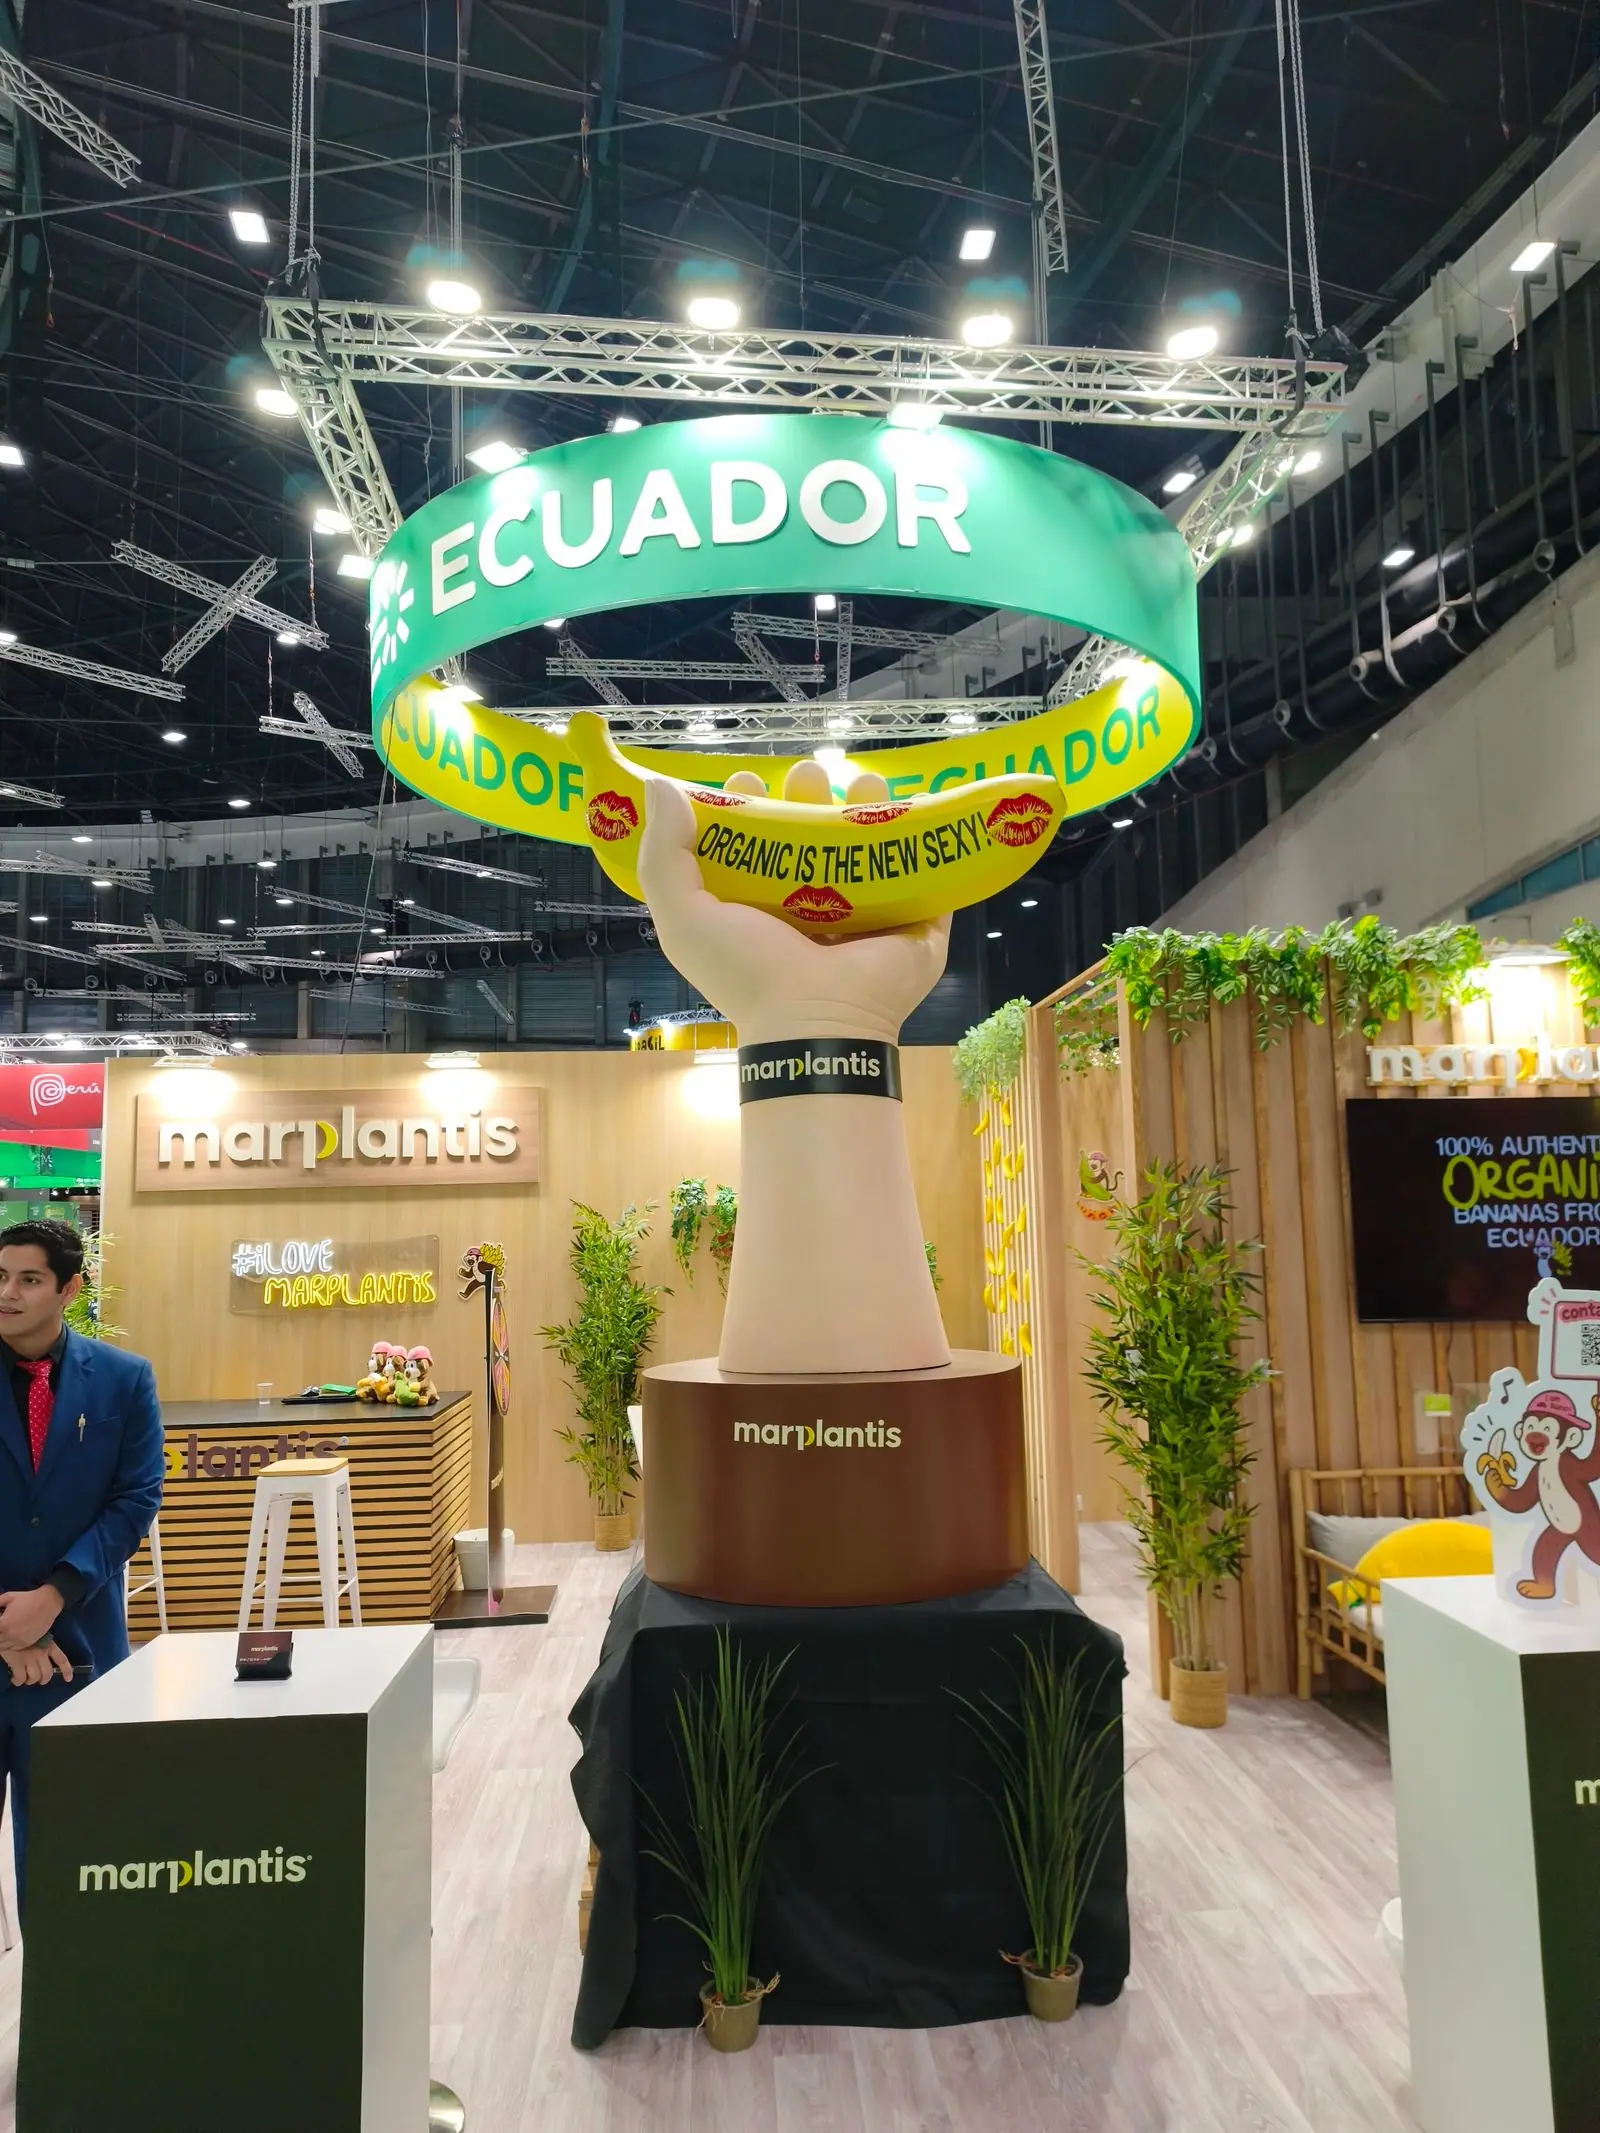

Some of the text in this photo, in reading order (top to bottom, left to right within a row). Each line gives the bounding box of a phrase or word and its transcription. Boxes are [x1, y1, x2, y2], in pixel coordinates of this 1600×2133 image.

[432, 459, 972, 616] ECUADOR
[388, 690, 583, 811] CUADOR
[698, 811, 992, 883] ORGANIC IS THE NEW SEXY!
[740, 1050, 881, 1083] marplantis
[1370, 1036, 1600, 1089] marpla
[158, 1105, 519, 1169] marplantis
[1435, 1136, 1494, 1156] 100%
[1454, 1203, 1559, 1225] BANANAS
[1487, 1226, 1600, 1248] ECUADOR
[733, 1419, 902, 1451] marplantis
[79, 1846, 307, 1893] marplantis
